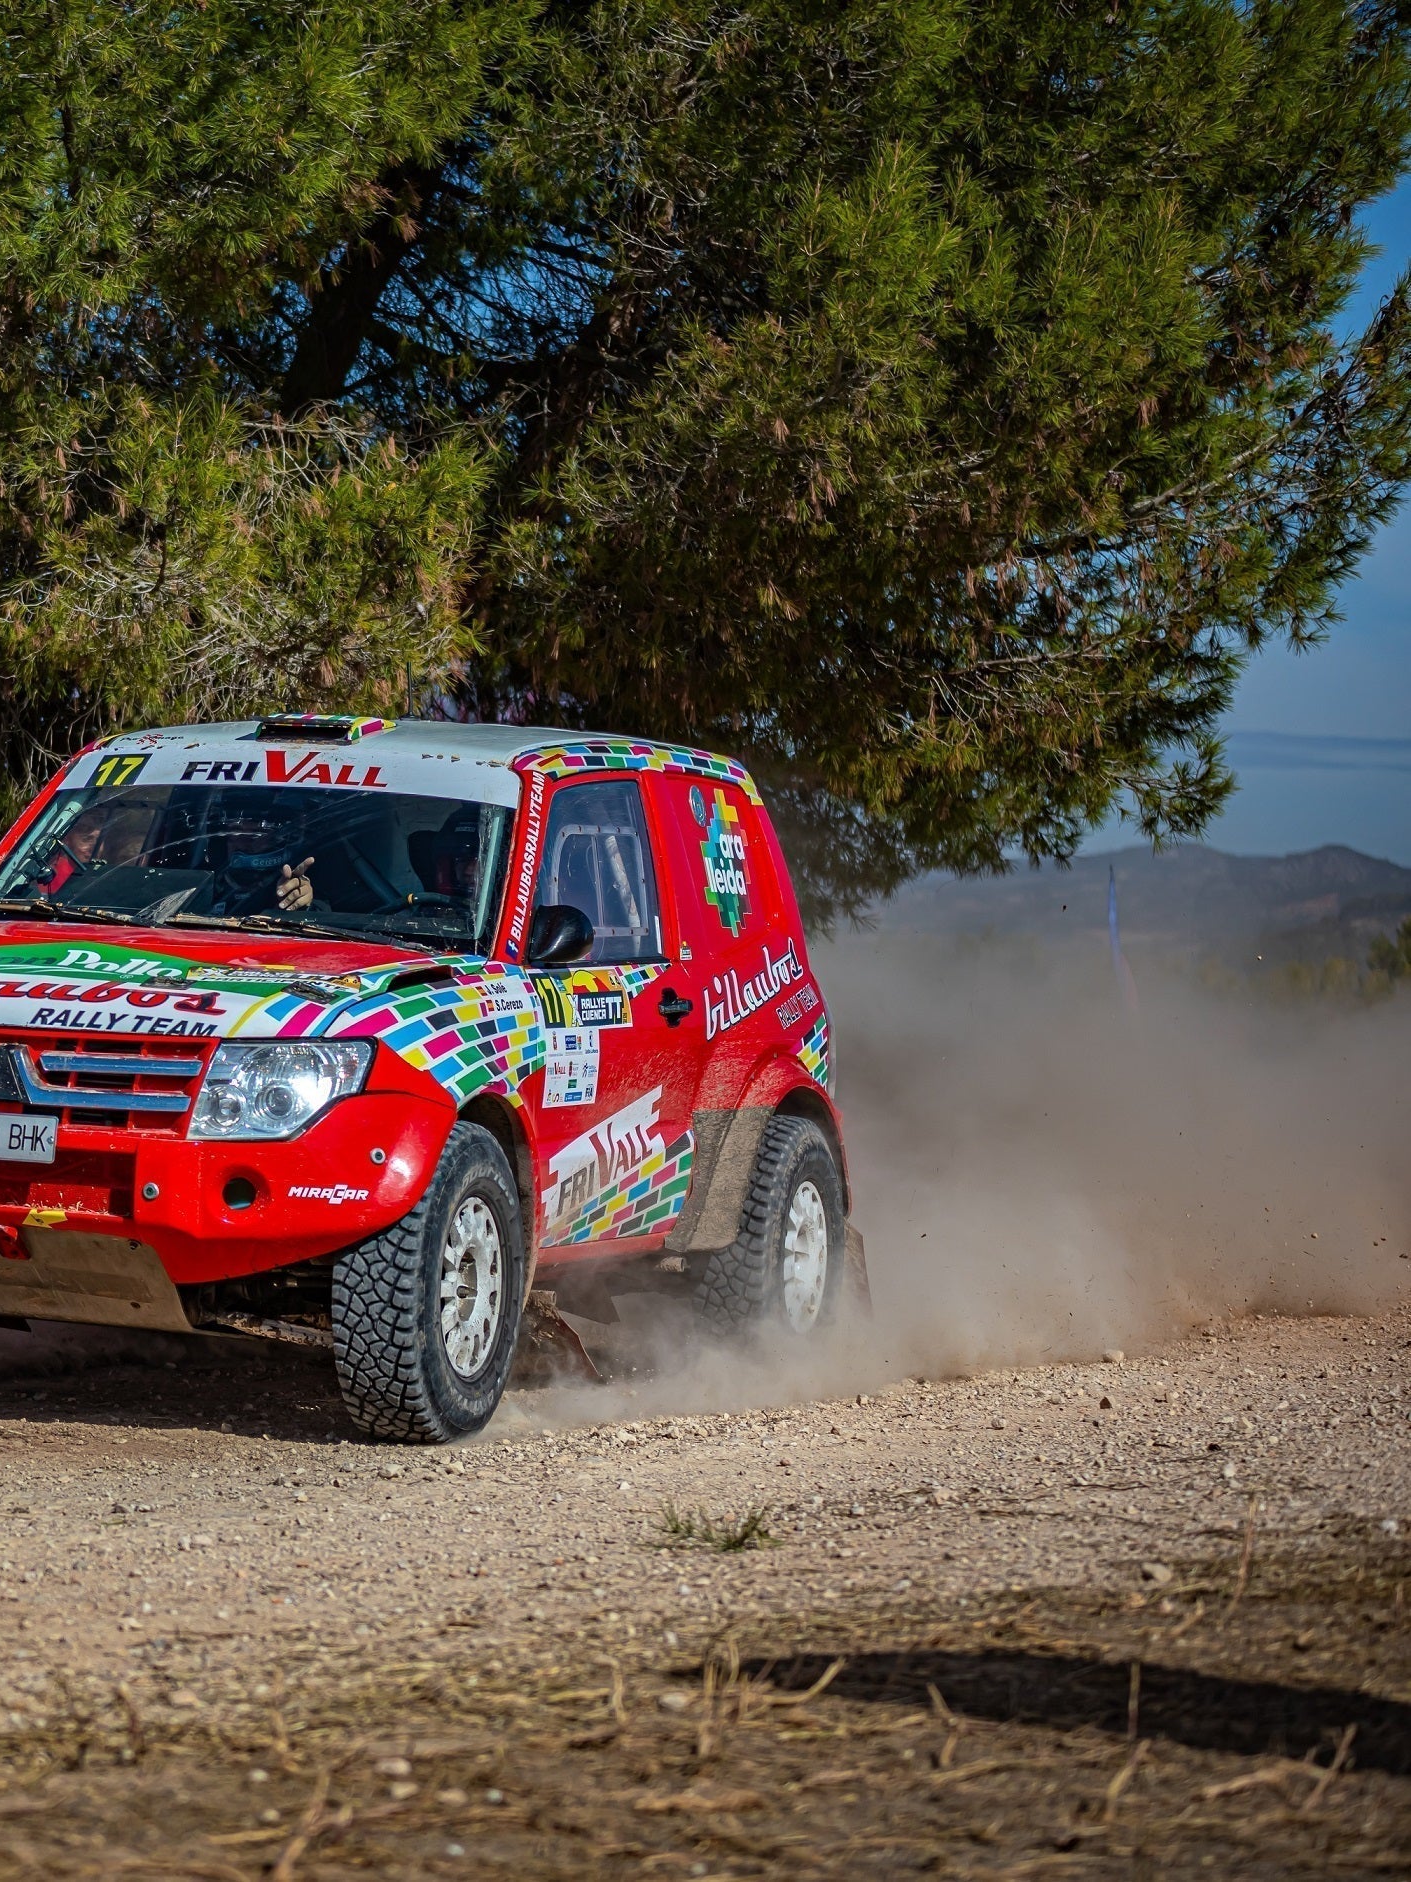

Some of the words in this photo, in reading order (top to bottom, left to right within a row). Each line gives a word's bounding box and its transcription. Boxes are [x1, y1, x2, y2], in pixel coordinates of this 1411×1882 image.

[96, 756, 145, 786] 17
[510, 771, 546, 942] BILLAUBOSRALLYTEAM
[719, 832, 746, 861] ara
[705, 857, 747, 896] lleida
[535, 978, 561, 1024] 17
[580, 997, 606, 1010] RALLYE
[605, 995, 623, 1020] TT
[581, 1009, 607, 1021] CUENCA
[775, 994, 803, 1030] RALLY
[29, 1007, 129, 1031] RALLY
[131, 1015, 219, 1037] TEAM
[8, 1123, 48, 1152] BHK
[287, 1183, 370, 1205] MIRACAR
